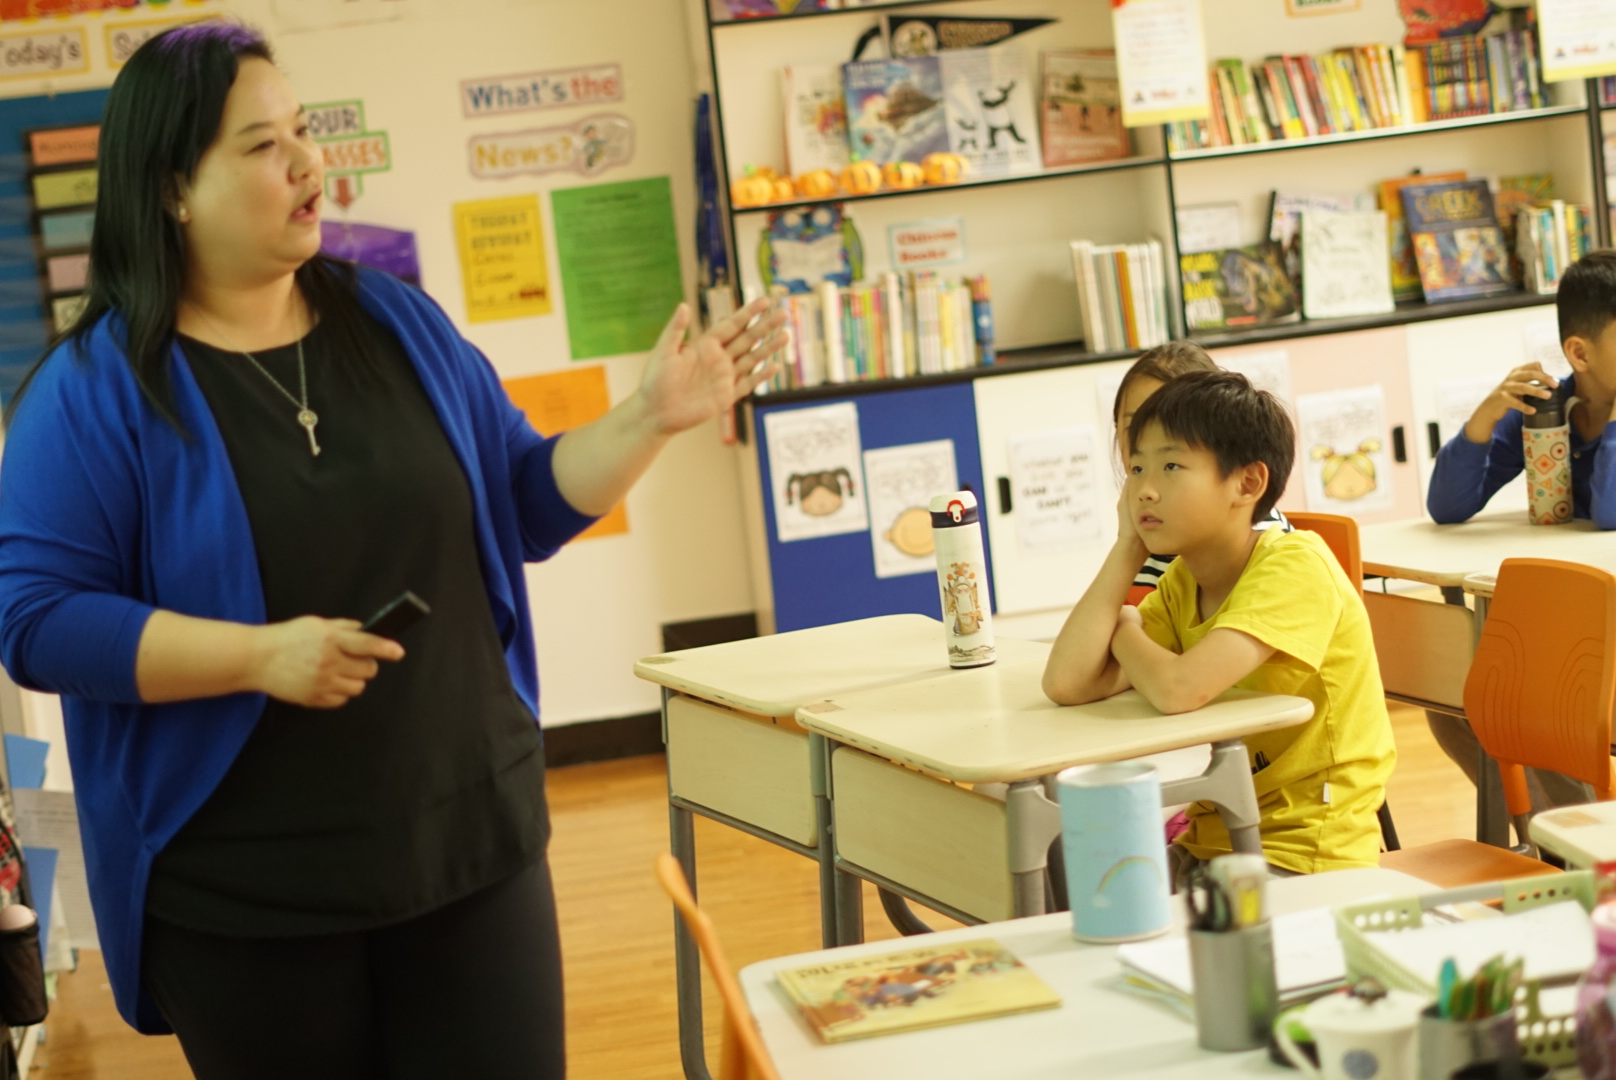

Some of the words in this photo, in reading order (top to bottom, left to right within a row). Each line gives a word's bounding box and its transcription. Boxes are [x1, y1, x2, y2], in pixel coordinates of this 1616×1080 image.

[0, 34, 82, 72] oday's
[467, 78, 567, 110] What's
[571, 74, 618, 101] the
[307, 108, 359, 135] OUR
[474, 135, 574, 171] News?
